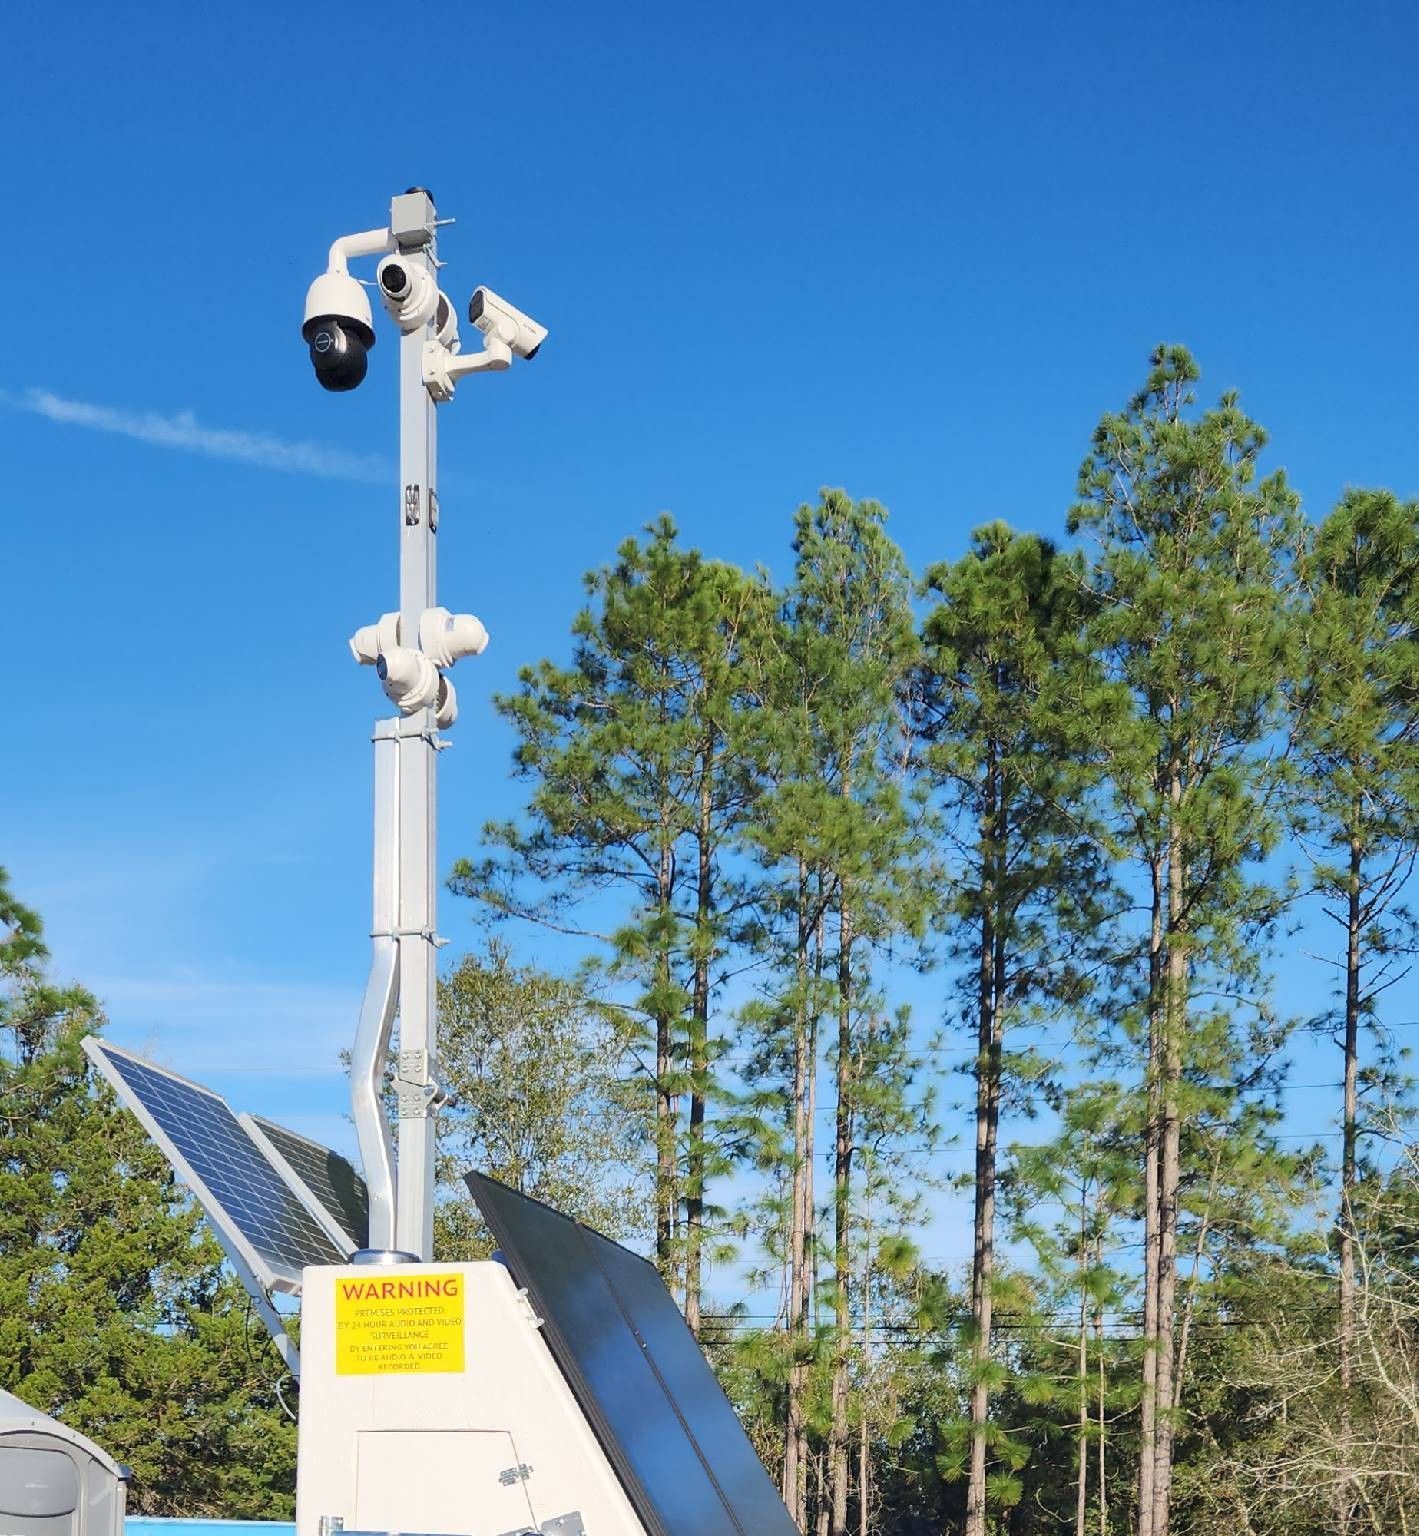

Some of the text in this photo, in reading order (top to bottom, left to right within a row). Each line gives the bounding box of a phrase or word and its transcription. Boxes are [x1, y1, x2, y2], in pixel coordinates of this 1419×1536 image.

[342, 1279, 459, 1301] WARNING
[355, 1306, 445, 1317] PREMISES PROTECTED
[338, 1317, 462, 1330] BY 24 HOUR AUDIO AND VIDEO
[371, 1330, 430, 1340] SURVEILLANCE
[361, 1343, 402, 1352] ENTERING
[422, 1342, 449, 1350] AGREE
[380, 1353, 407, 1361] AUDIO
[418, 1352, 443, 1360] VIDEO
[378, 1362, 421, 1370] RECORDED
